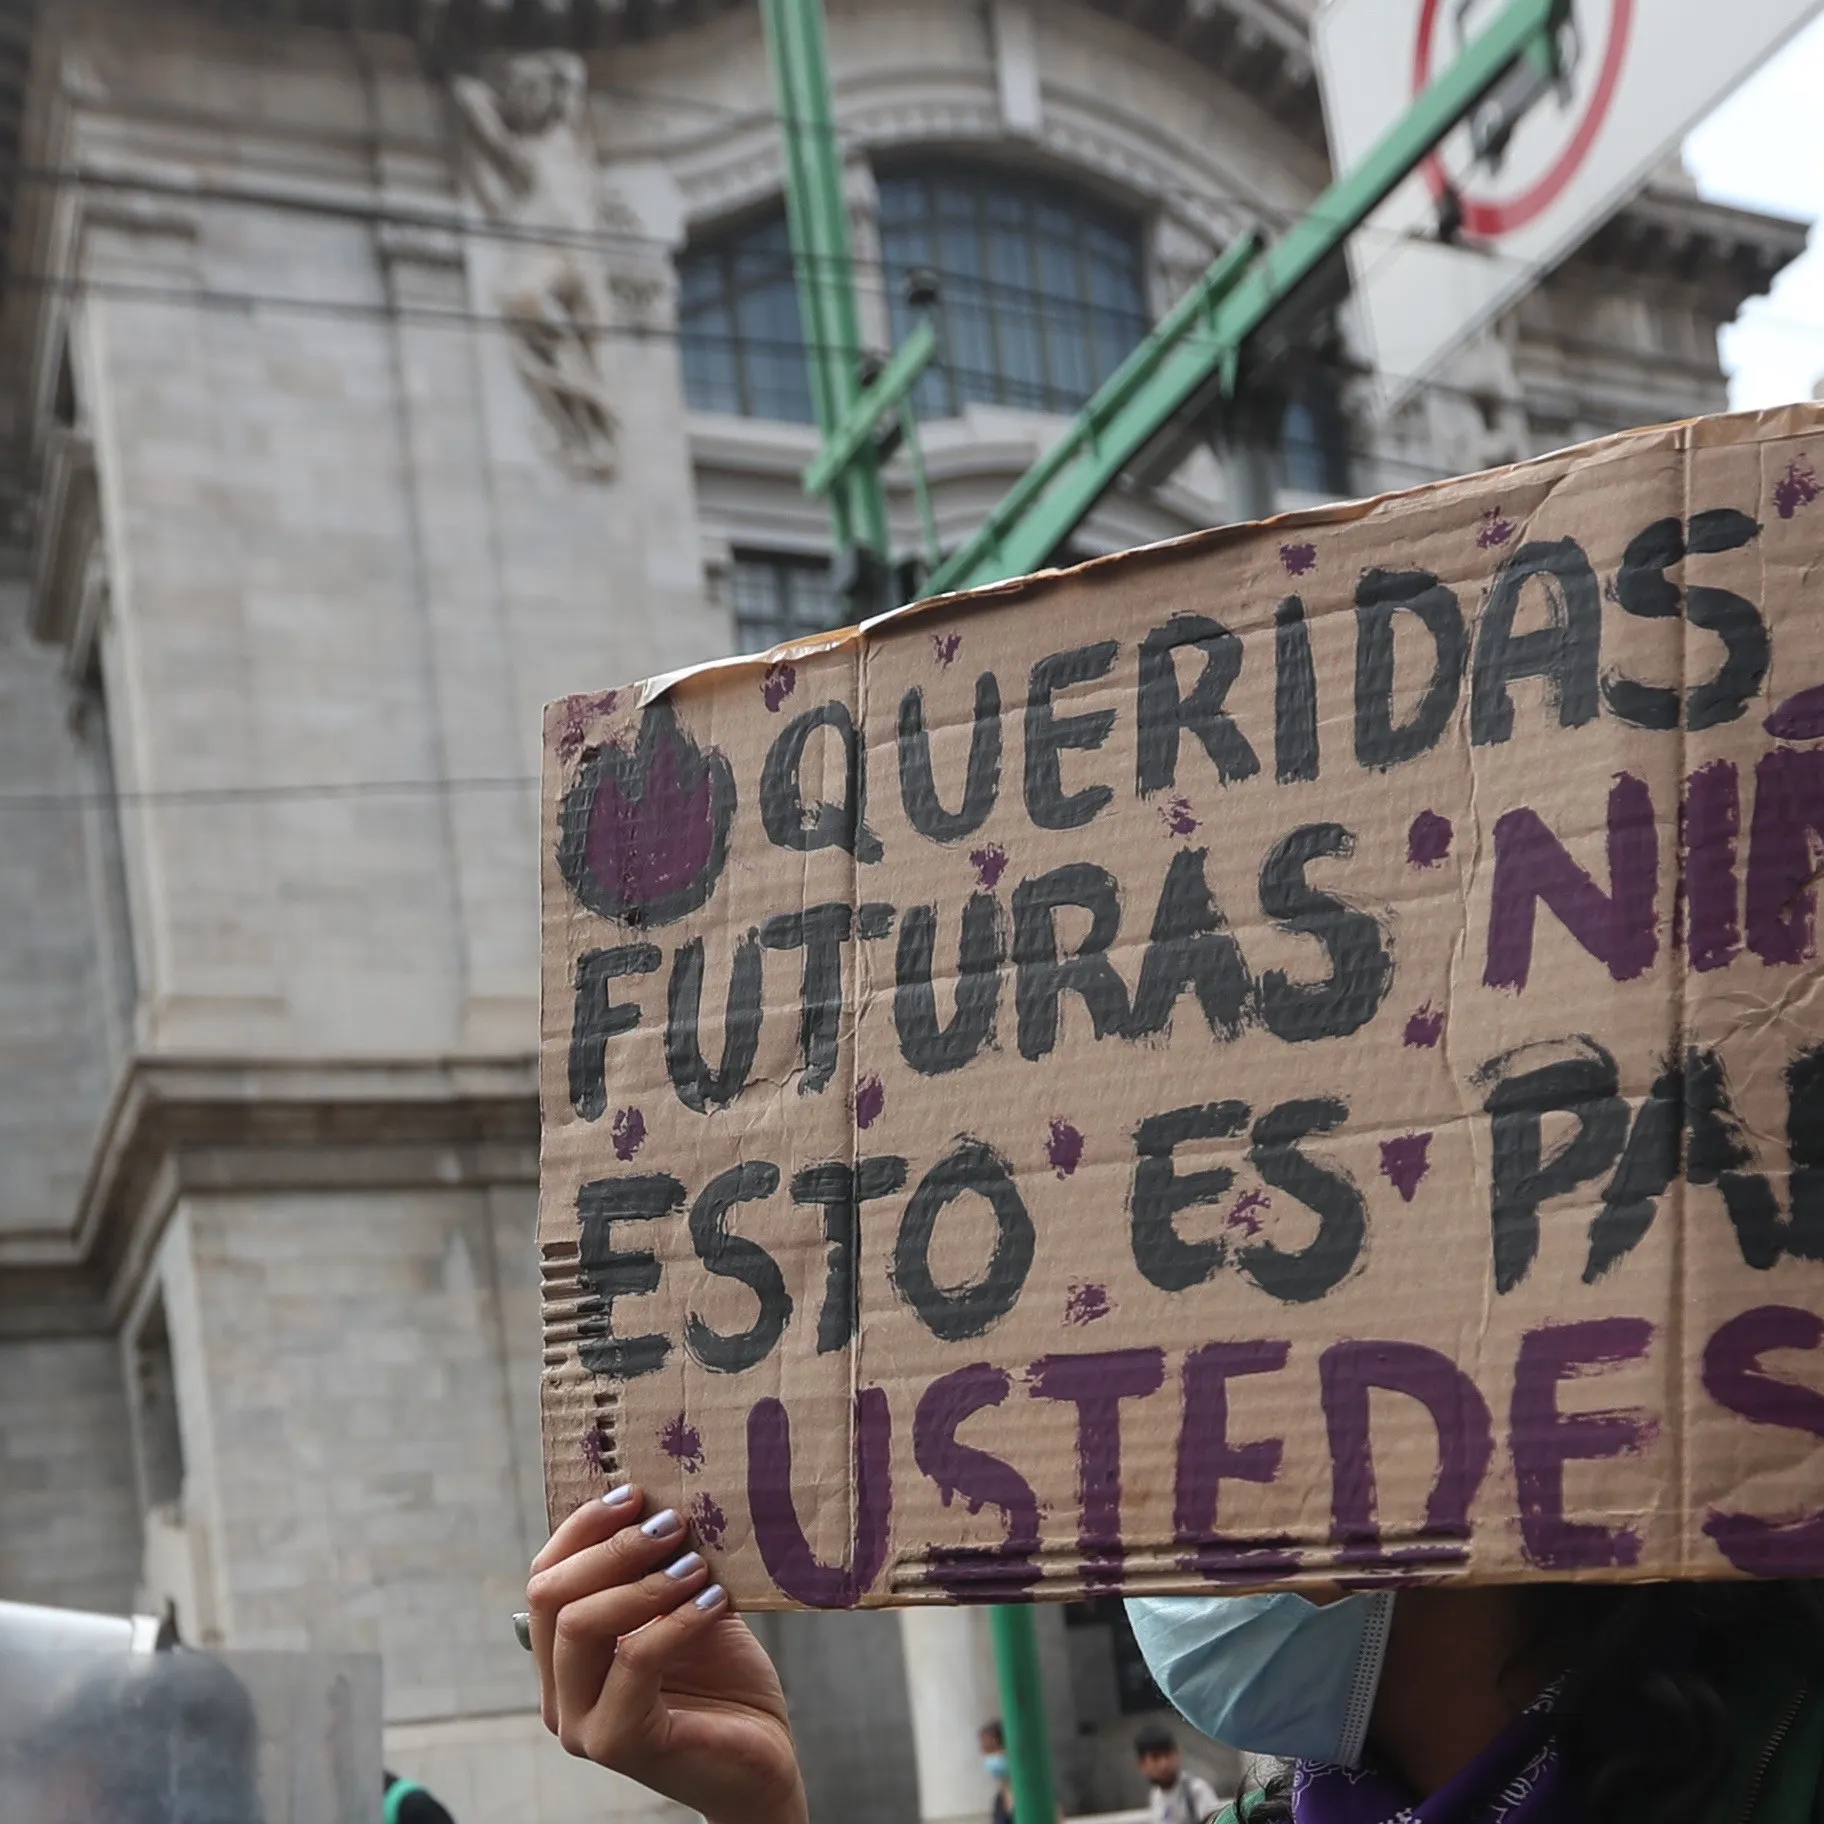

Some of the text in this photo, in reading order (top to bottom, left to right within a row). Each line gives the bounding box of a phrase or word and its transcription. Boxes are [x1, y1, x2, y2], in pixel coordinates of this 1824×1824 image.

[761, 508, 1771, 865] QUERIDAS
[566, 821, 1397, 1124] FUTURAS
[577, 1131, 1037, 1380] ESTO
[1130, 1098, 1372, 1303] ES
